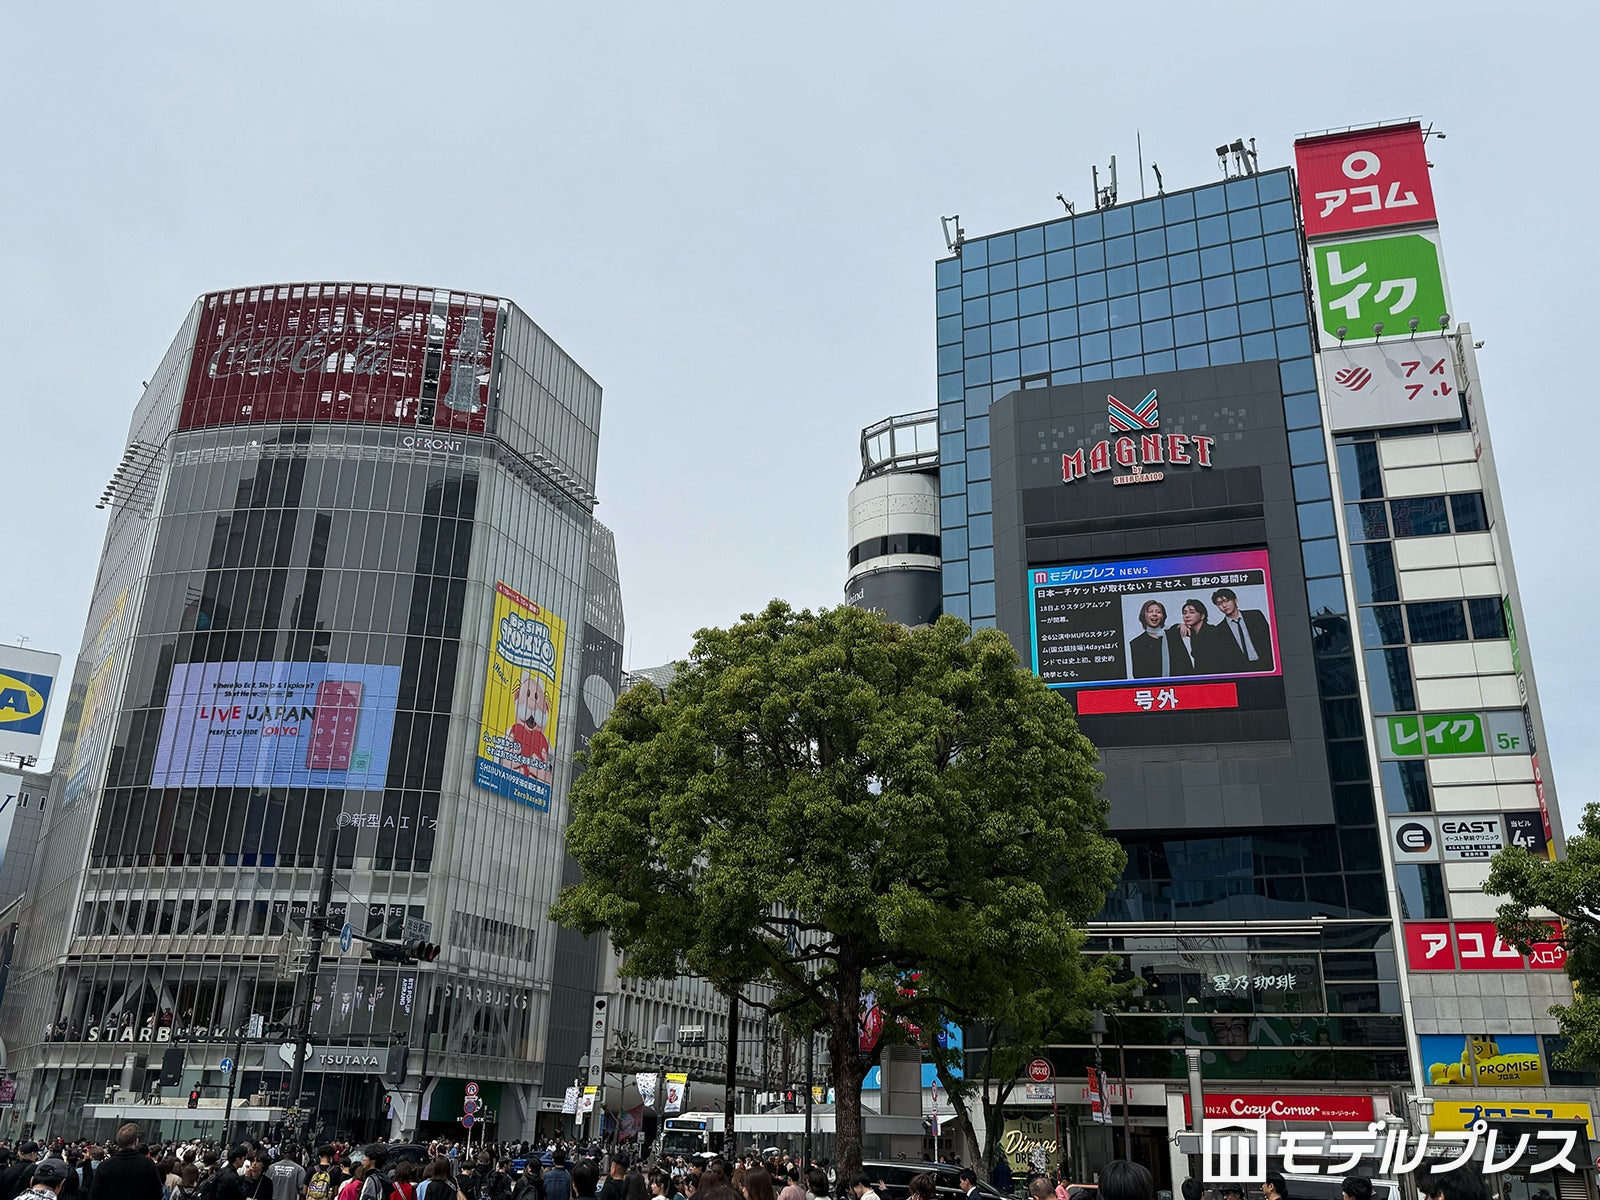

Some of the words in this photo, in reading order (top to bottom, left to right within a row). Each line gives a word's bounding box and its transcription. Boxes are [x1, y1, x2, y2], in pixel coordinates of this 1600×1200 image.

[1315, 182, 1419, 218] アコム
[402, 435, 462, 453] QFRONT
[1061, 433, 1216, 484] MAGNET
[1132, 465, 1142, 475] by
[1112, 471, 1164, 486] SHIBUYA109
[1050, 567, 1115, 581] モデルプレス
[1119, 567, 1149, 576] NEWS
[1134, 688, 1179, 711] 号外
[200, 705, 241, 723] LIVE
[247, 705, 317, 723] JAPAN
[1394, 719, 1475, 745] レイク
[1496, 733, 1520, 749] 5F
[1441, 820, 1498, 834] EAST
[1510, 819, 1532, 828] 当ビル
[1512, 829, 1536, 849] 4F
[369, 906, 403, 917] CAFE
[1531, 950, 1554, 964] 入口
[1212, 973, 1298, 993] 星乃珈琲
[320, 1054, 379, 1066] TSUTAYA
[1479, 1060, 1538, 1075] PROMISE
[1081, 1083, 1134, 1099] MNET
[1205, 1106, 1228, 1114] INZA
[1230, 1098, 1272, 1119] Cozy
[1271, 1100, 1320, 1116] Corner
[1020, 1123, 1043, 1134] LIVE
[1016, 1153, 1050, 1164] DRES
